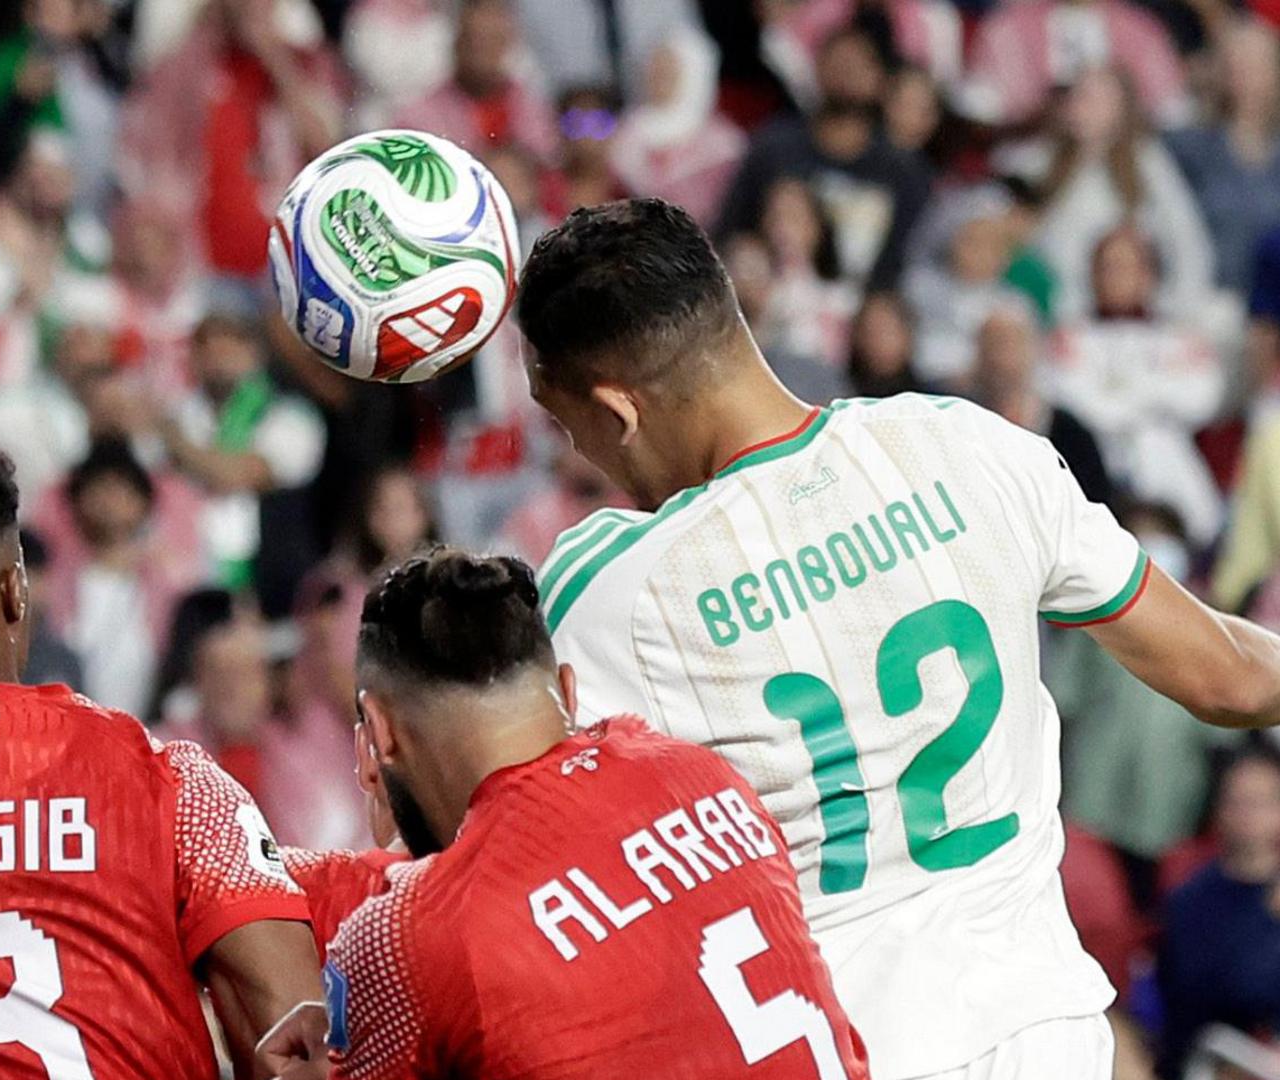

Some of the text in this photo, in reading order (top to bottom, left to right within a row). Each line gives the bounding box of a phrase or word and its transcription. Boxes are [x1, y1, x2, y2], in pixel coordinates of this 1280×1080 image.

[331, 214, 380, 282] TRIONDA
[697, 480, 967, 647] BENBOUALI
[762, 598, 1020, 895] 12
